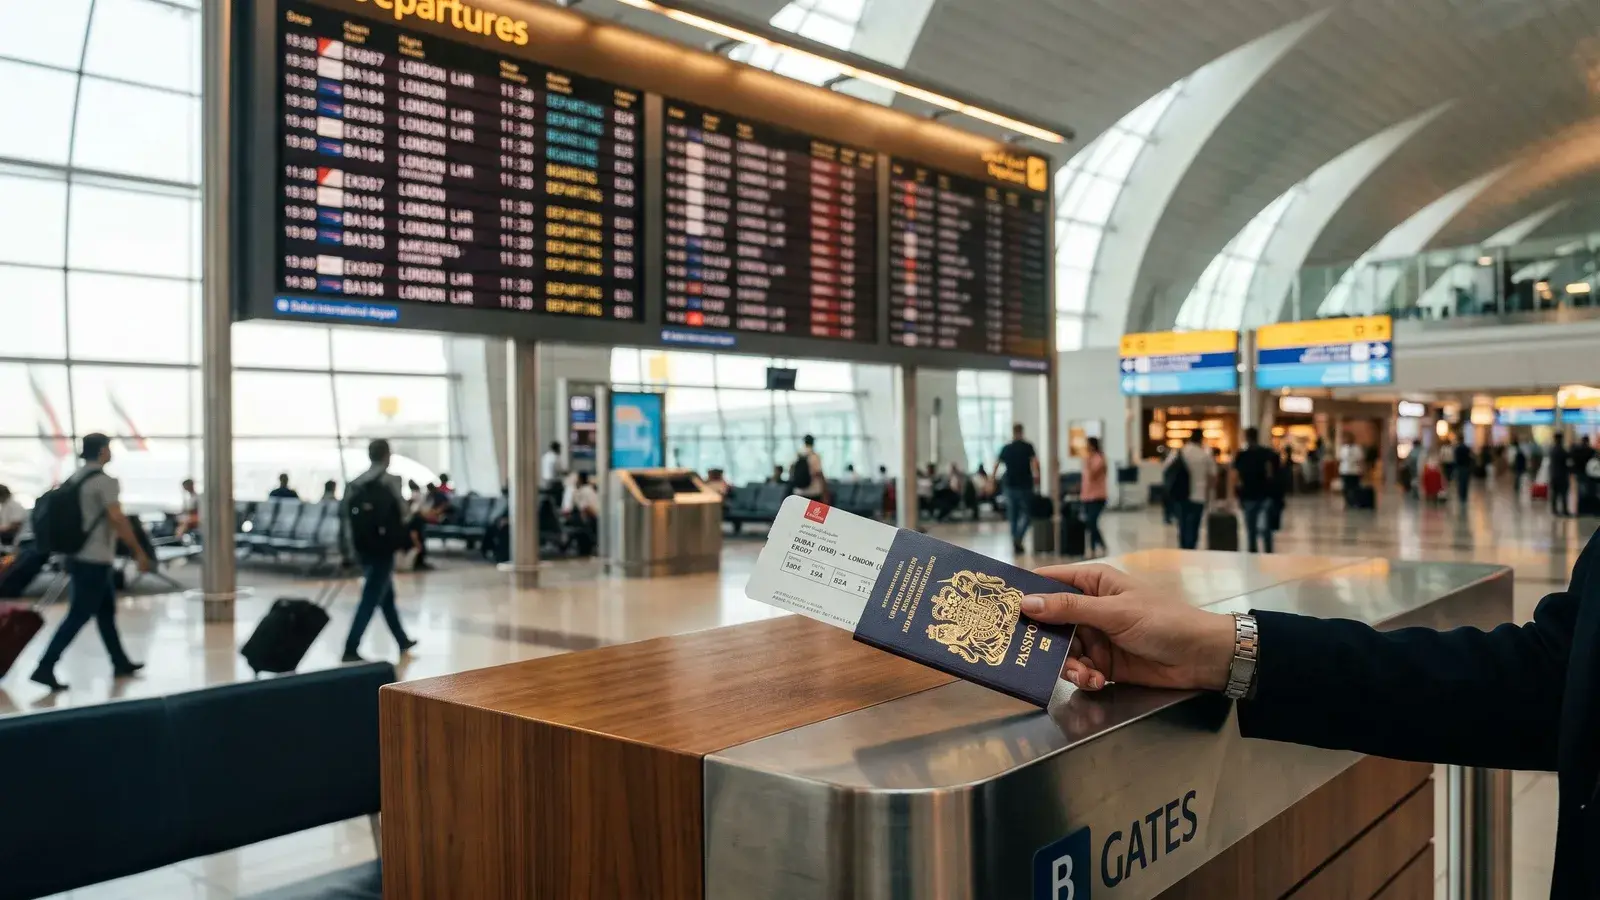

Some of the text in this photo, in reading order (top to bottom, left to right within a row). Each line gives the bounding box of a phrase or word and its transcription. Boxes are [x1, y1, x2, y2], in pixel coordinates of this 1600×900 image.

[355, 0, 529, 46] partures
[398, 60, 446, 82] LONDON
[398, 79, 446, 101] LONDON
[398, 98, 446, 119] LONDON
[398, 116, 446, 137] LONDON
[398, 135, 446, 156] LONDON
[398, 154, 446, 174] LONDON
[398, 183, 446, 202] LONDON
[398, 201, 446, 220] LONDON
[398, 220, 446, 239] LONDON
[398, 267, 446, 284] LONDON
[398, 285, 446, 302] LONDON
[794, 536, 815, 548] DUBAI
[847, 554, 875, 568] LONDON
[1015, 624, 1038, 668] PASSPO
[1052, 789, 1198, 900] B GATES
